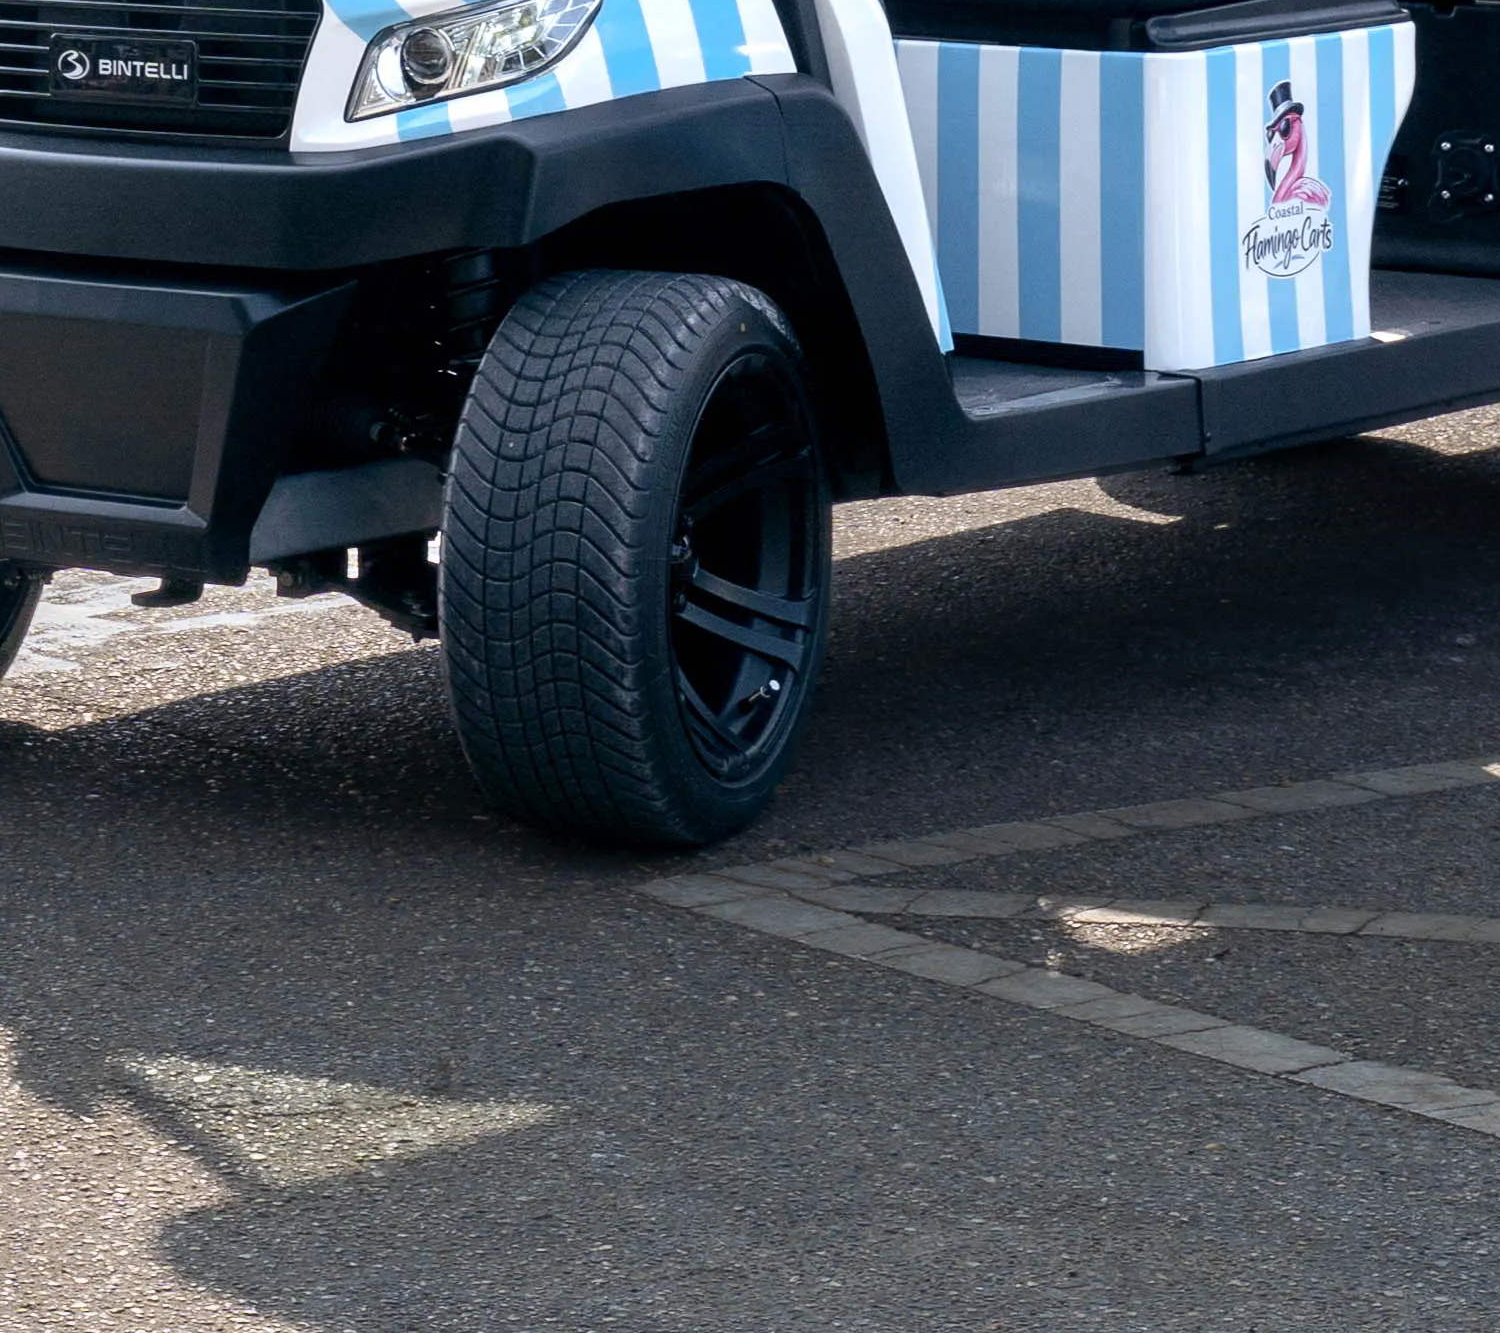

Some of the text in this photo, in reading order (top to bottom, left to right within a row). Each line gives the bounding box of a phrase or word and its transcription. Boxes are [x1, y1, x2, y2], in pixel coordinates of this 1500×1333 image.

[98, 59, 188, 80] BINTELLI
[1268, 201, 1304, 221] Coastal
[1242, 216, 1332, 270] Flamingo Carts
